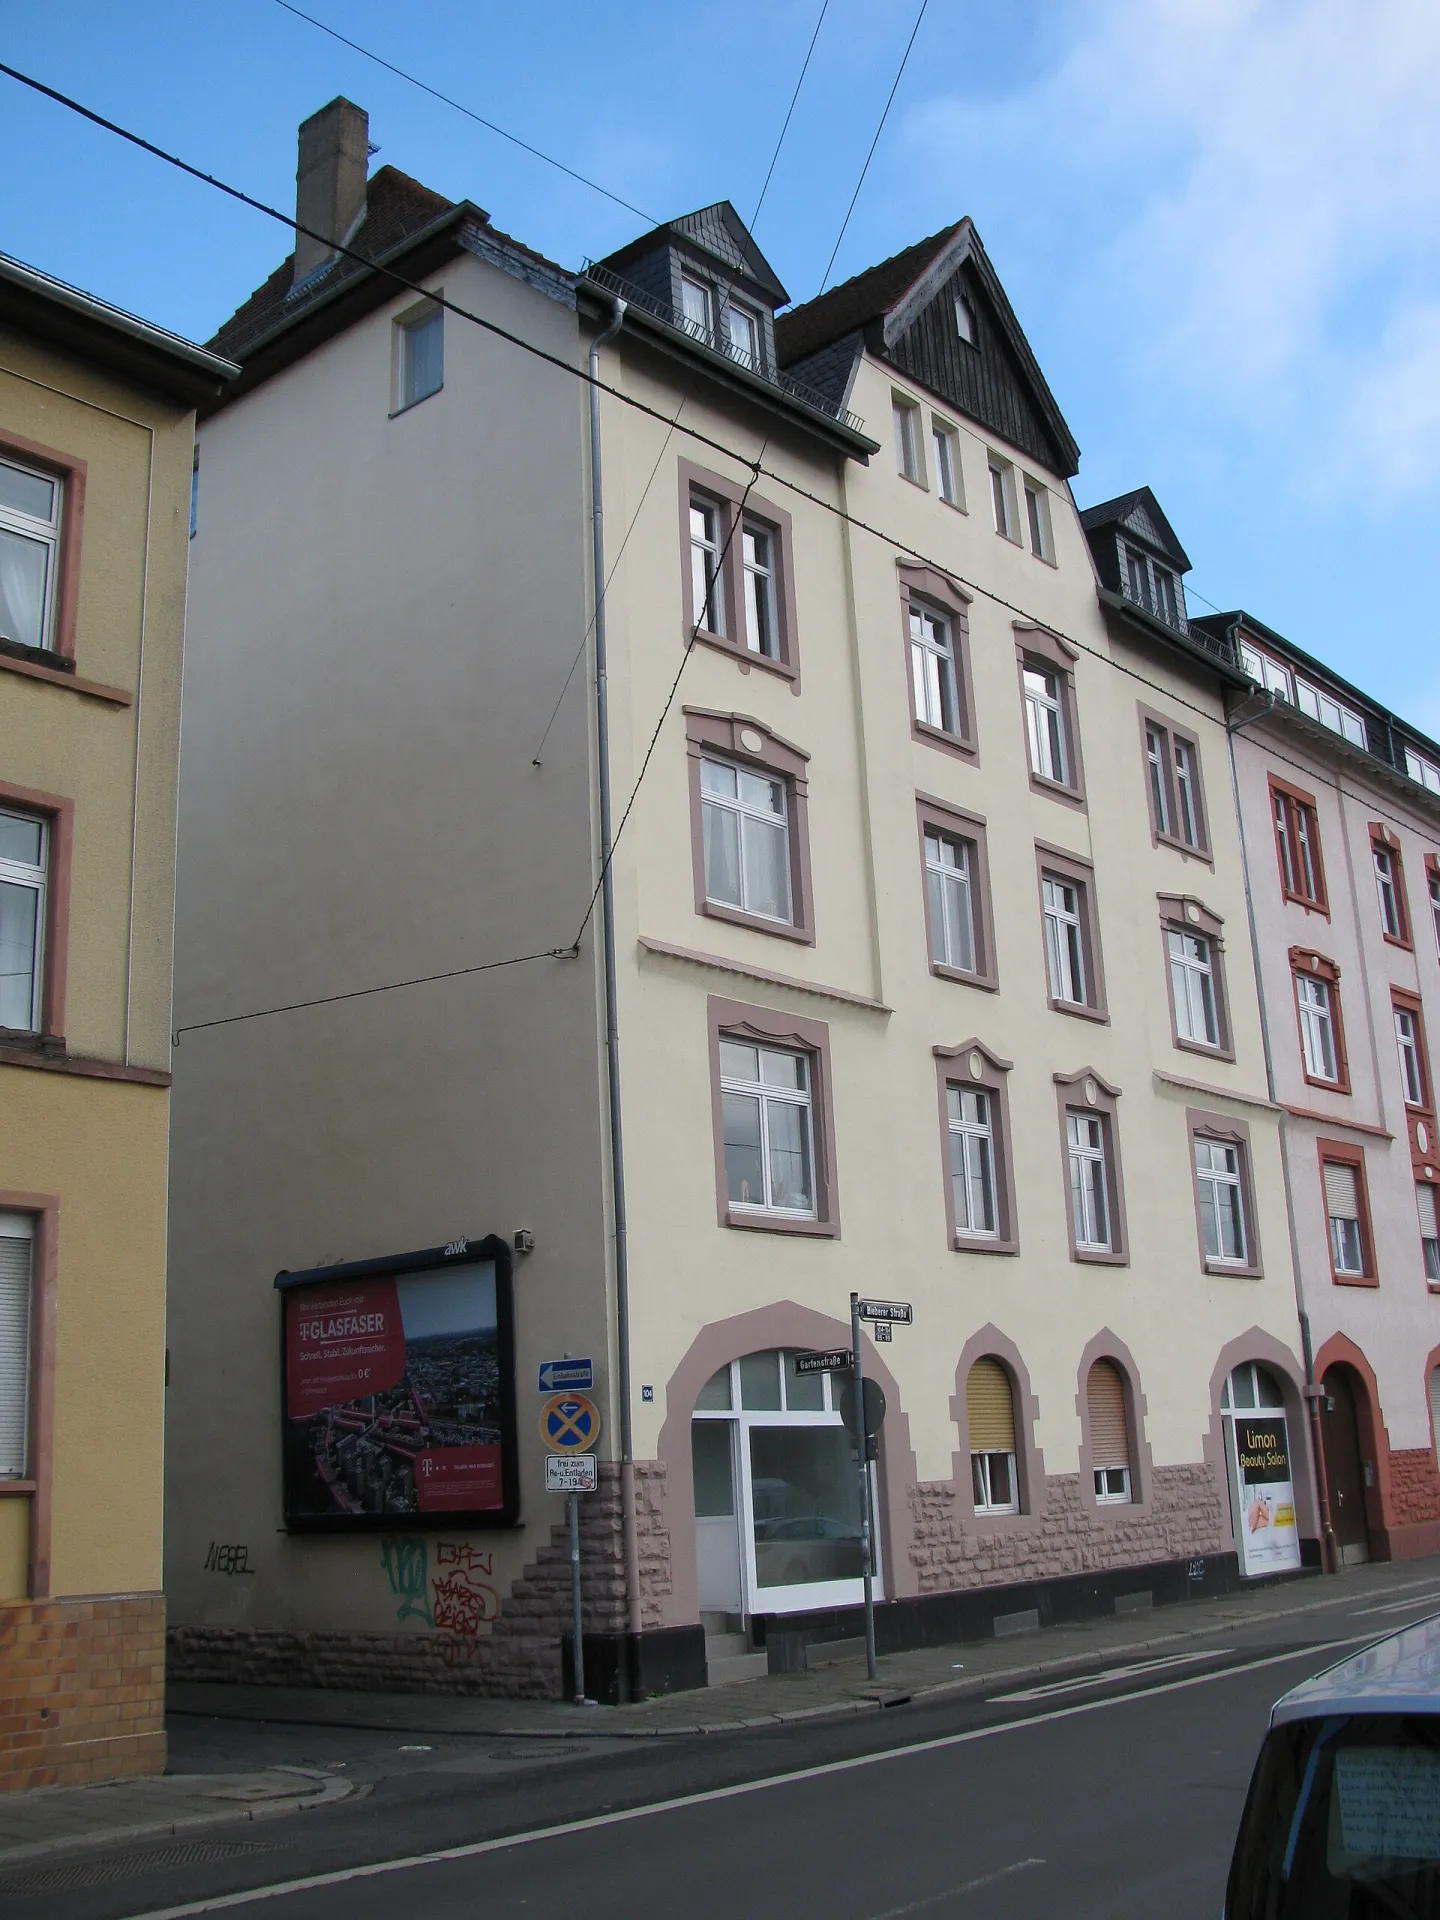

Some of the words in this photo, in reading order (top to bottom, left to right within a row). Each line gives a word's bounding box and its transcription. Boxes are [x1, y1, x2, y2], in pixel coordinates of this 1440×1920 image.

[445, 1236, 468, 1256] awk
[867, 1305, 889, 1316] Bieberer
[890, 1307, 907, 1319] Straße
[310, 1312, 384, 1340] GLASFASER
[800, 1355, 841, 1370] Gartenstraße
[1246, 1429, 1277, 1449] Limon
[557, 1459, 569, 1468] frei
[570, 1460, 585, 1468] zum
[1240, 1453, 1266, 1470] Beauty
[1266, 1451, 1286, 1466] Salon
